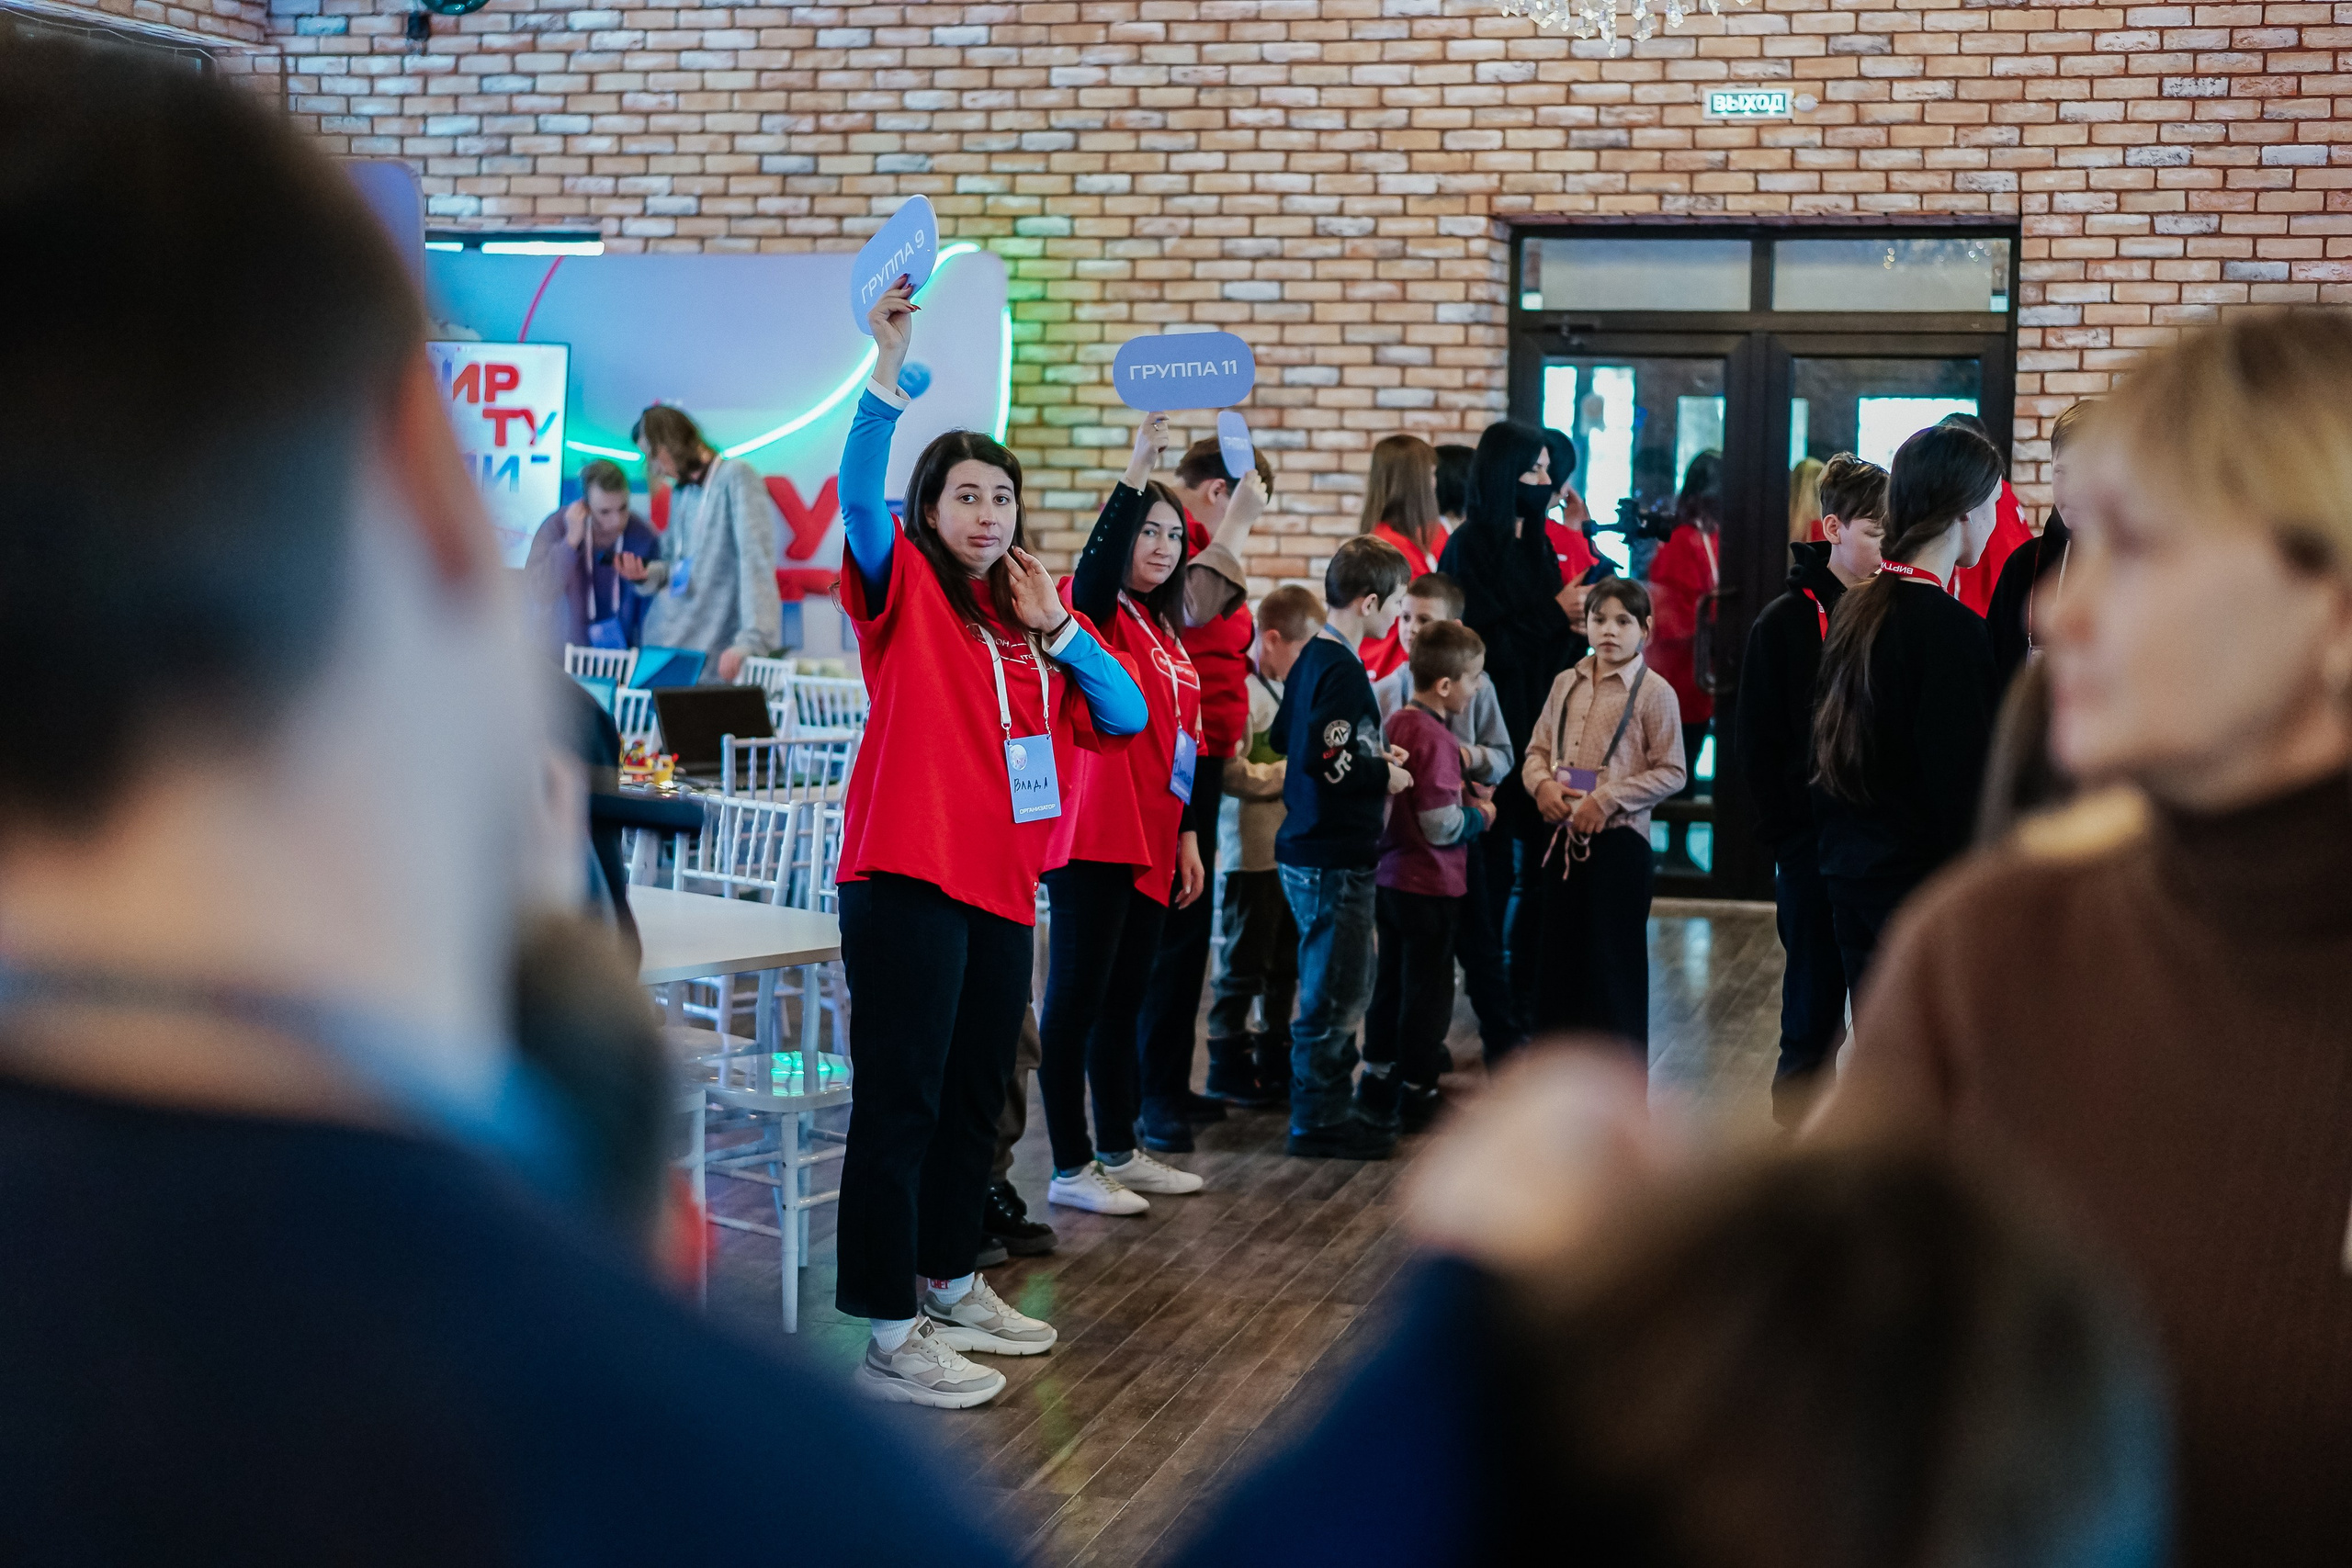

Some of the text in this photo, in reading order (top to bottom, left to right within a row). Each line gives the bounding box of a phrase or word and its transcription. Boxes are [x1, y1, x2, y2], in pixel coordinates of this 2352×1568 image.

[1713, 95, 1784, 112] ВЫХОД
[861, 229, 925, 305] ГРУППА 9
[1129, 359, 1238, 380] ГРУППА 11
[442, 362, 521, 403] ИР
[1019, 803, 1056, 815] ОРГАНИЗАТОР
